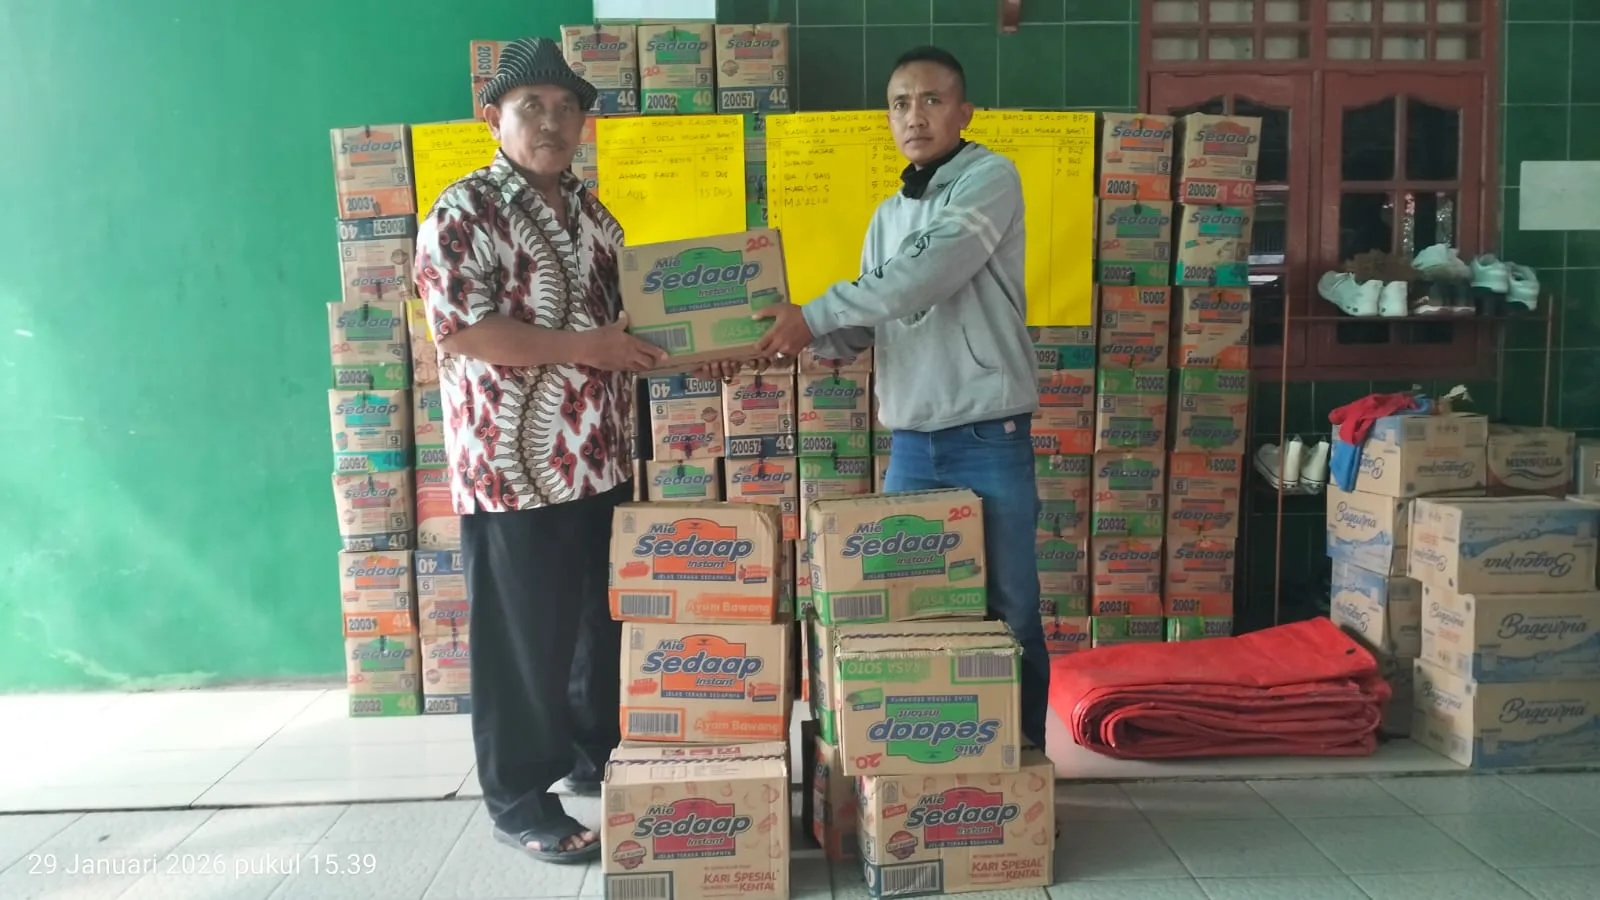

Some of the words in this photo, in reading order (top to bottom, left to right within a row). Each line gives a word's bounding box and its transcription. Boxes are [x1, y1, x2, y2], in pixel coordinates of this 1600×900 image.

[572, 38, 628, 52] Sedaap
[645, 36, 708, 52] Sedaap
[725, 36, 780, 52] Sedaap
[776, 70, 785, 82] 9
[617, 89, 636, 106] 40
[646, 93, 678, 109] 20032
[692, 89, 712, 106] 40
[722, 91, 754, 108] 20057
[768, 87, 788, 106] 40
[1111, 125, 1173, 141] Sedaap
[1194, 130, 1258, 145] Sedaap
[339, 139, 402, 155] Sedaap
[1161, 160, 1169, 173] 9
[1188, 158, 1208, 169] 20
[1187, 183, 1217, 197] 20030
[1107, 213, 1170, 226] Sedaap
[1188, 212, 1250, 226] Sedaap
[340, 223, 359, 240] 40
[374, 218, 407, 235] 20057
[746, 236, 770, 252] 20
[655, 256, 682, 269] Mie
[351, 275, 406, 286] Sedaap
[642, 261, 762, 294] Sedaap
[1189, 300, 1250, 313] Sedaap
[335, 315, 402, 330] Sedaap
[1102, 344, 1164, 357] Sedaap
[338, 369, 370, 386] 20032
[1135, 376, 1164, 390] 20032
[1217, 375, 1246, 389] 20032
[651, 384, 672, 399] 40
[684, 377, 718, 393] 20057
[802, 385, 865, 398] Sedaap
[732, 388, 786, 400] Sedaap
[335, 403, 400, 416] Sedaap
[800, 411, 818, 423] 20
[854, 415, 863, 428] 9
[416, 423, 434, 435] 20
[1100, 428, 1163, 442] Sedaap
[1181, 427, 1242, 440] Sedaap
[389, 434, 400, 445] 9
[661, 431, 715, 444] Sedaap
[775, 434, 796, 450] 40
[802, 436, 833, 450] 20032
[847, 434, 866, 448] 40
[730, 439, 762, 455] 20057
[338, 456, 369, 470] 20092
[835, 458, 867, 473] 20032
[730, 470, 793, 484] Sedaap
[1098, 466, 1161, 478] Sedaap
[653, 473, 713, 486] Sedaap
[343, 487, 398, 500] Sedaap
[783, 502, 792, 513] 9
[948, 505, 972, 522] 20
[394, 517, 404, 528] 9
[1171, 509, 1234, 523] Sedaap
[649, 523, 677, 535] Mie
[854, 522, 884, 534] Mie
[1097, 518, 1127, 531] 20032
[388, 534, 408, 549] 40
[633, 534, 755, 562] Sedaap
[841, 531, 962, 560] Sedaap
[1098, 549, 1160, 561] Sedaap
[1173, 548, 1235, 560] Sedaap
[345, 564, 408, 579] Sedaap
[418, 558, 438, 574] 40
[398, 595, 407, 607] 9
[949, 592, 983, 605] SOTO
[1172, 598, 1201, 611] 20031
[686, 600, 720, 613] Ayam
[722, 601, 771, 615] Bawang
[657, 639, 685, 651] Mie
[351, 647, 414, 662] Sedaap
[641, 651, 764, 681] Sedaap
[846, 660, 883, 675] SOTO
[887, 659, 921, 673] RASA
[352, 698, 382, 713] 20032
[694, 717, 730, 731] Ayam
[731, 719, 780, 734] Bawang
[868, 717, 1002, 747] Sedaap
[953, 744, 985, 757] Mie
[855, 752, 882, 770] 20
[919, 795, 946, 806] Mie
[647, 805, 676, 817] Mie
[905, 803, 1020, 830] Sedaap
[633, 814, 754, 840] Sedaap
[972, 861, 1000, 873] KARI
[1000, 858, 1043, 871] SPESIAL
[704, 873, 731, 885] KARI
[733, 870, 777, 883] SPESIAL
[1006, 868, 1042, 880] KENTAL
[740, 881, 776, 893] KENTAL
